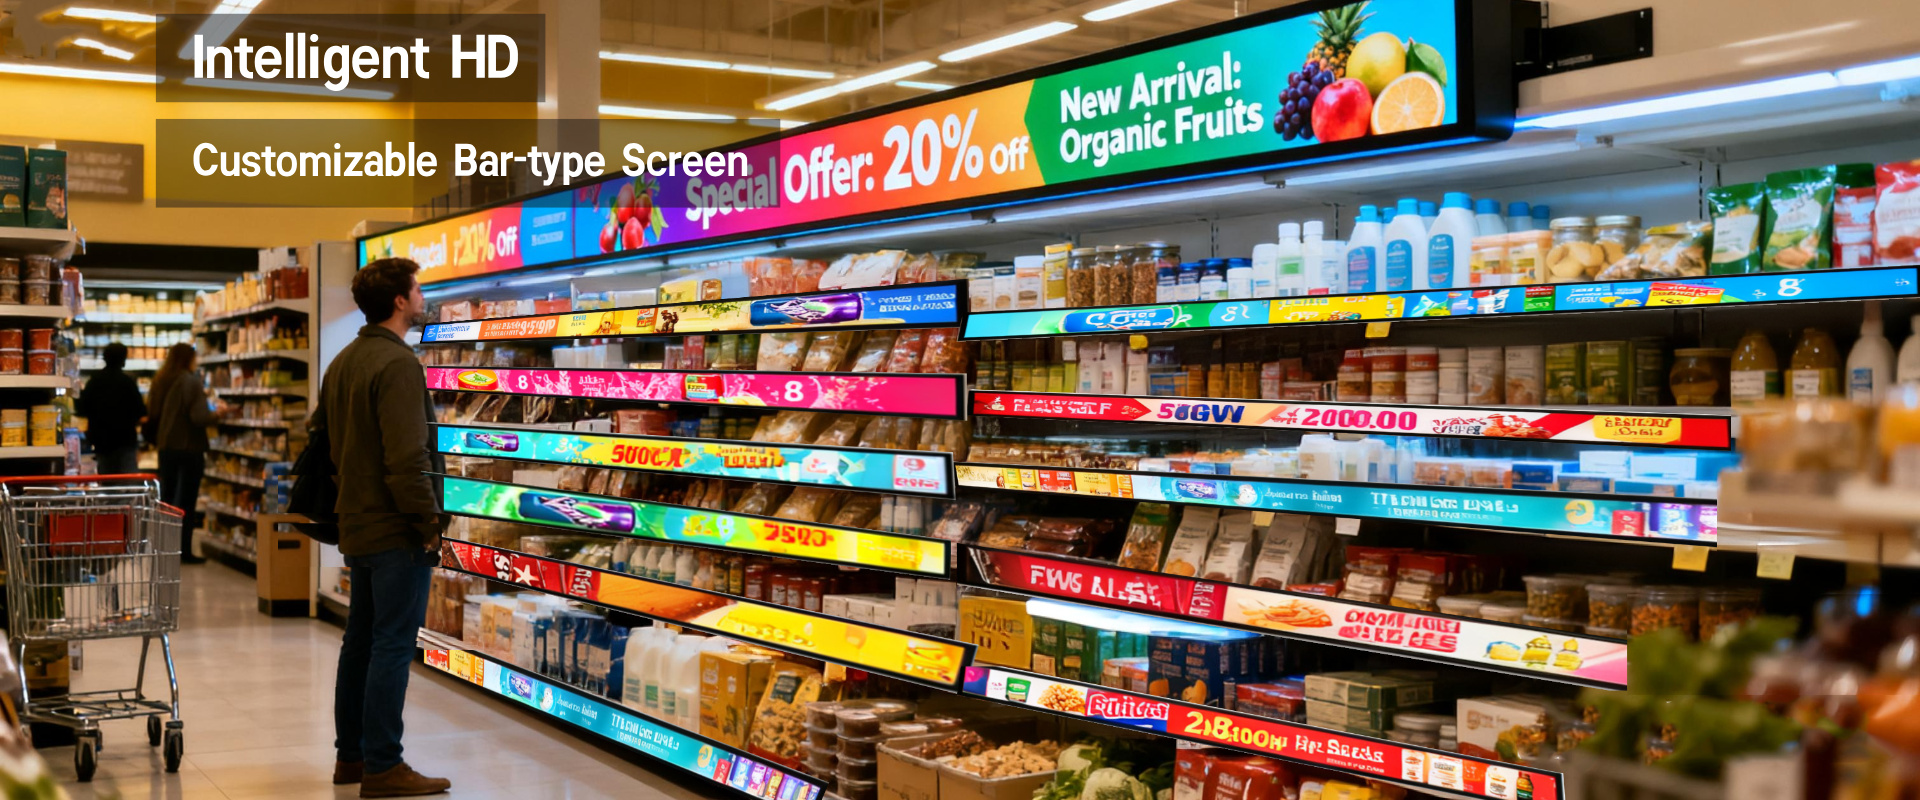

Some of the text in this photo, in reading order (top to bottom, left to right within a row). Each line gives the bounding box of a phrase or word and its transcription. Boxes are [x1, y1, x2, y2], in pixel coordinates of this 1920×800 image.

[1060, 50, 1241, 124] New Arrival:
[1059, 96, 1264, 168] Organic Fruits
[685, 155, 778, 230] Special
[784, 143, 875, 204] Offer:
[883, 108, 984, 191] 20%
[783, 380, 804, 402] 8
